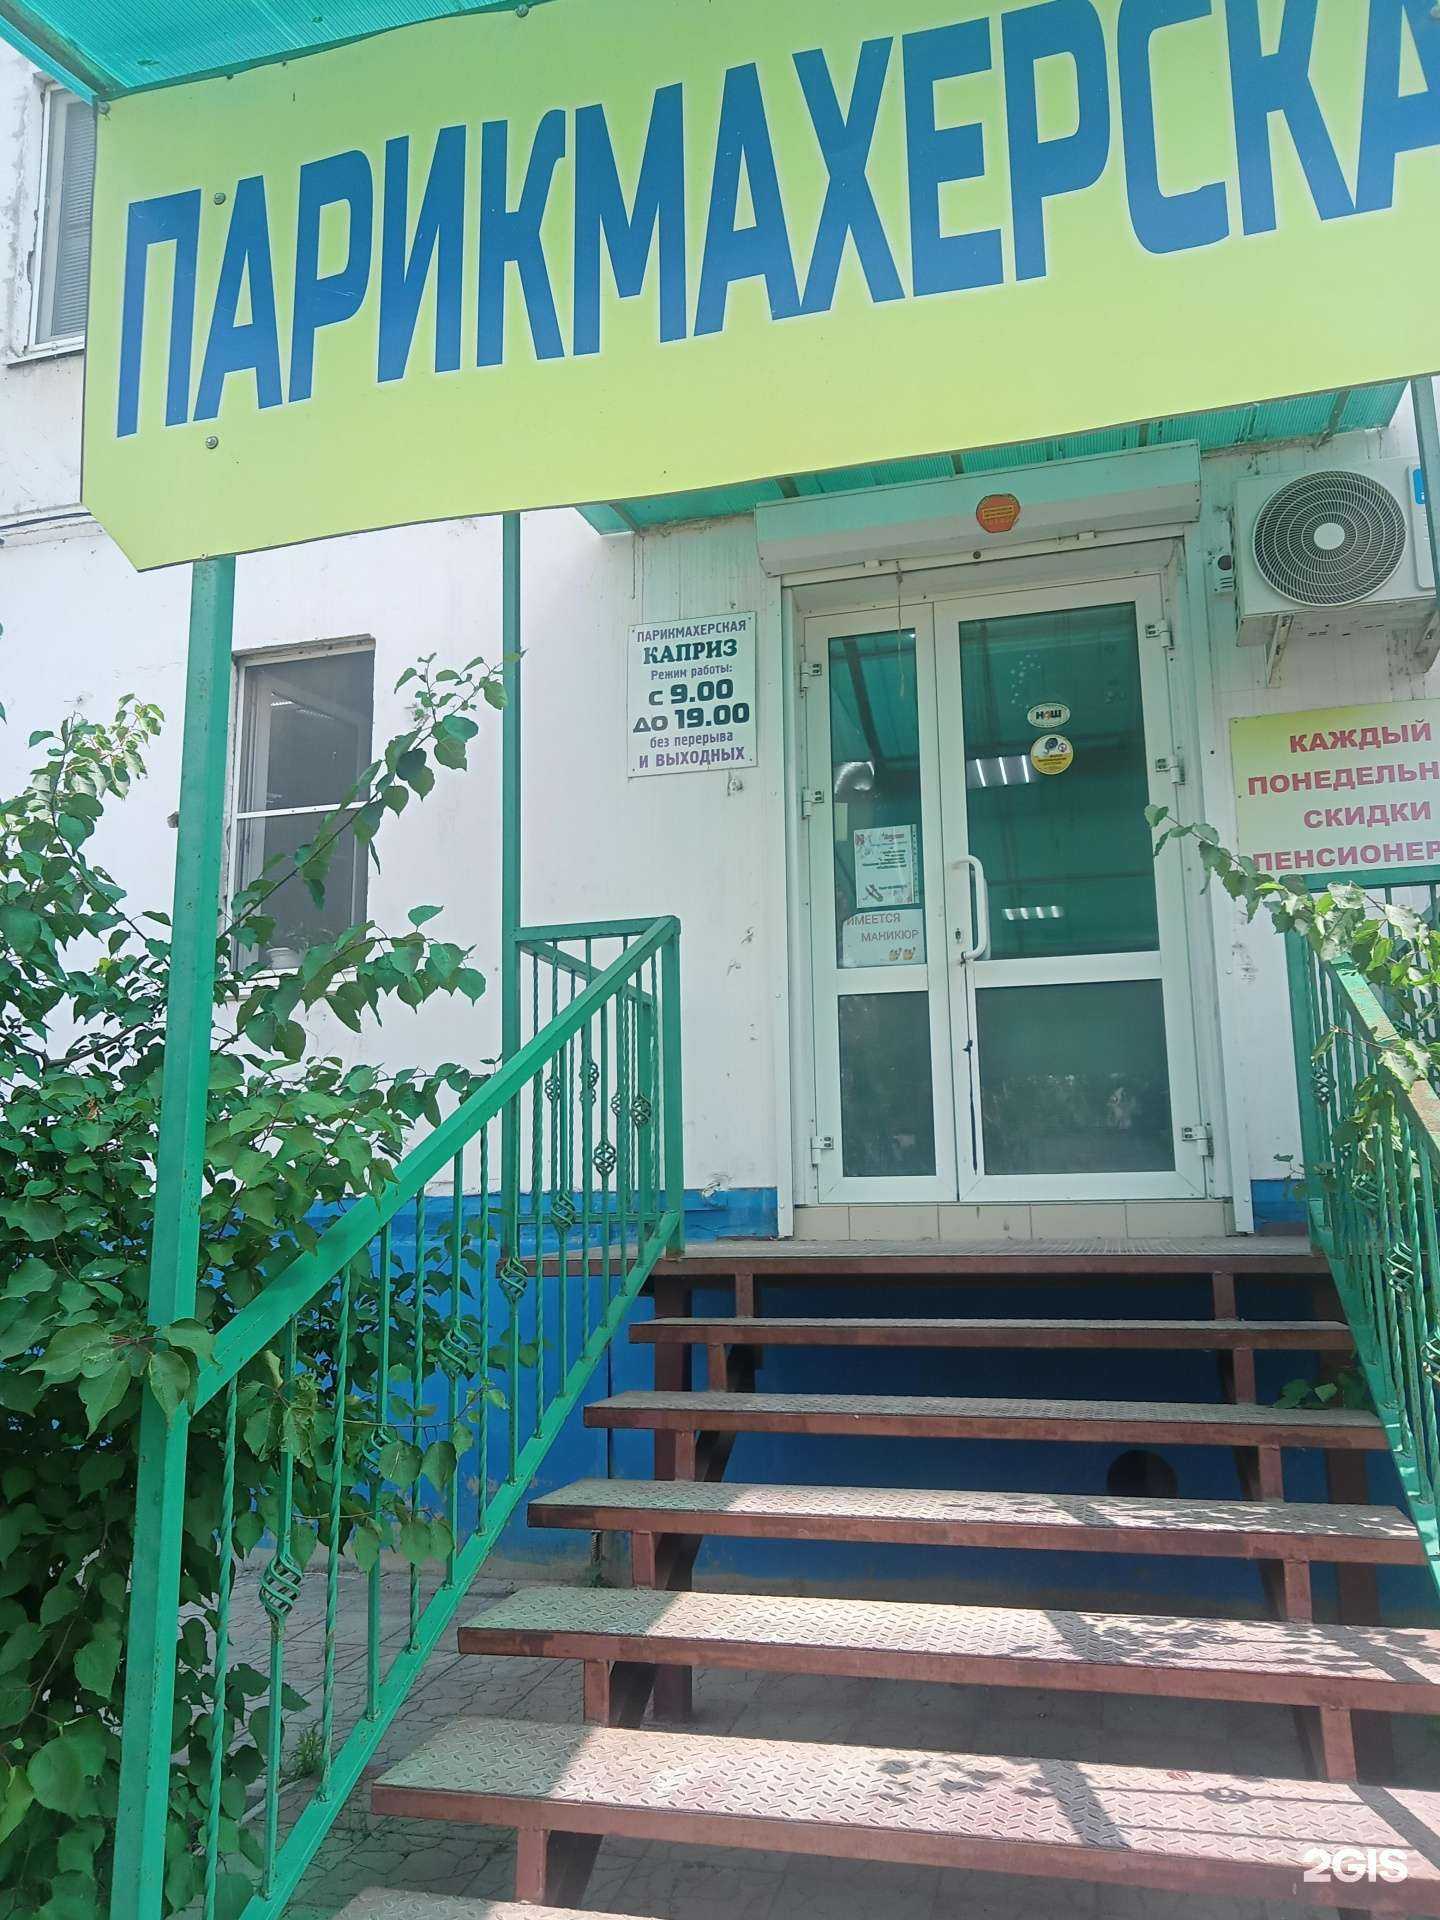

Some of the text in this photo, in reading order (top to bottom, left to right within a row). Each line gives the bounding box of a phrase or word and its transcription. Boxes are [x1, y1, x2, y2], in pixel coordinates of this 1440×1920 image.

[116, 0, 1440, 437] ПАРИКМАХЕРСКА
[637, 620, 746, 642] ПАРИКМАХЕРСКАЯ
[643, 638, 738, 664] КАПРИЗ
[651, 664, 733, 681] Режим работы:
[670, 678, 734, 704] 9.00
[674, 702, 750, 729] 19.00
[650, 731, 734, 749] без перерыва
[1289, 719, 1432, 753] КАЖДЫЙ
[655, 746, 745, 768] ВЫХОДНЫХ
[1248, 761, 1440, 795] ПОНЕДЕЛЬН
[1303, 801, 1431, 828] СКИДКИ
[1252, 841, 1440, 871] ПЕНСИОНЕР
[847, 912, 901, 926] ИМЕЕТСЯ
[861, 929, 919, 943] МАНИКЮР
